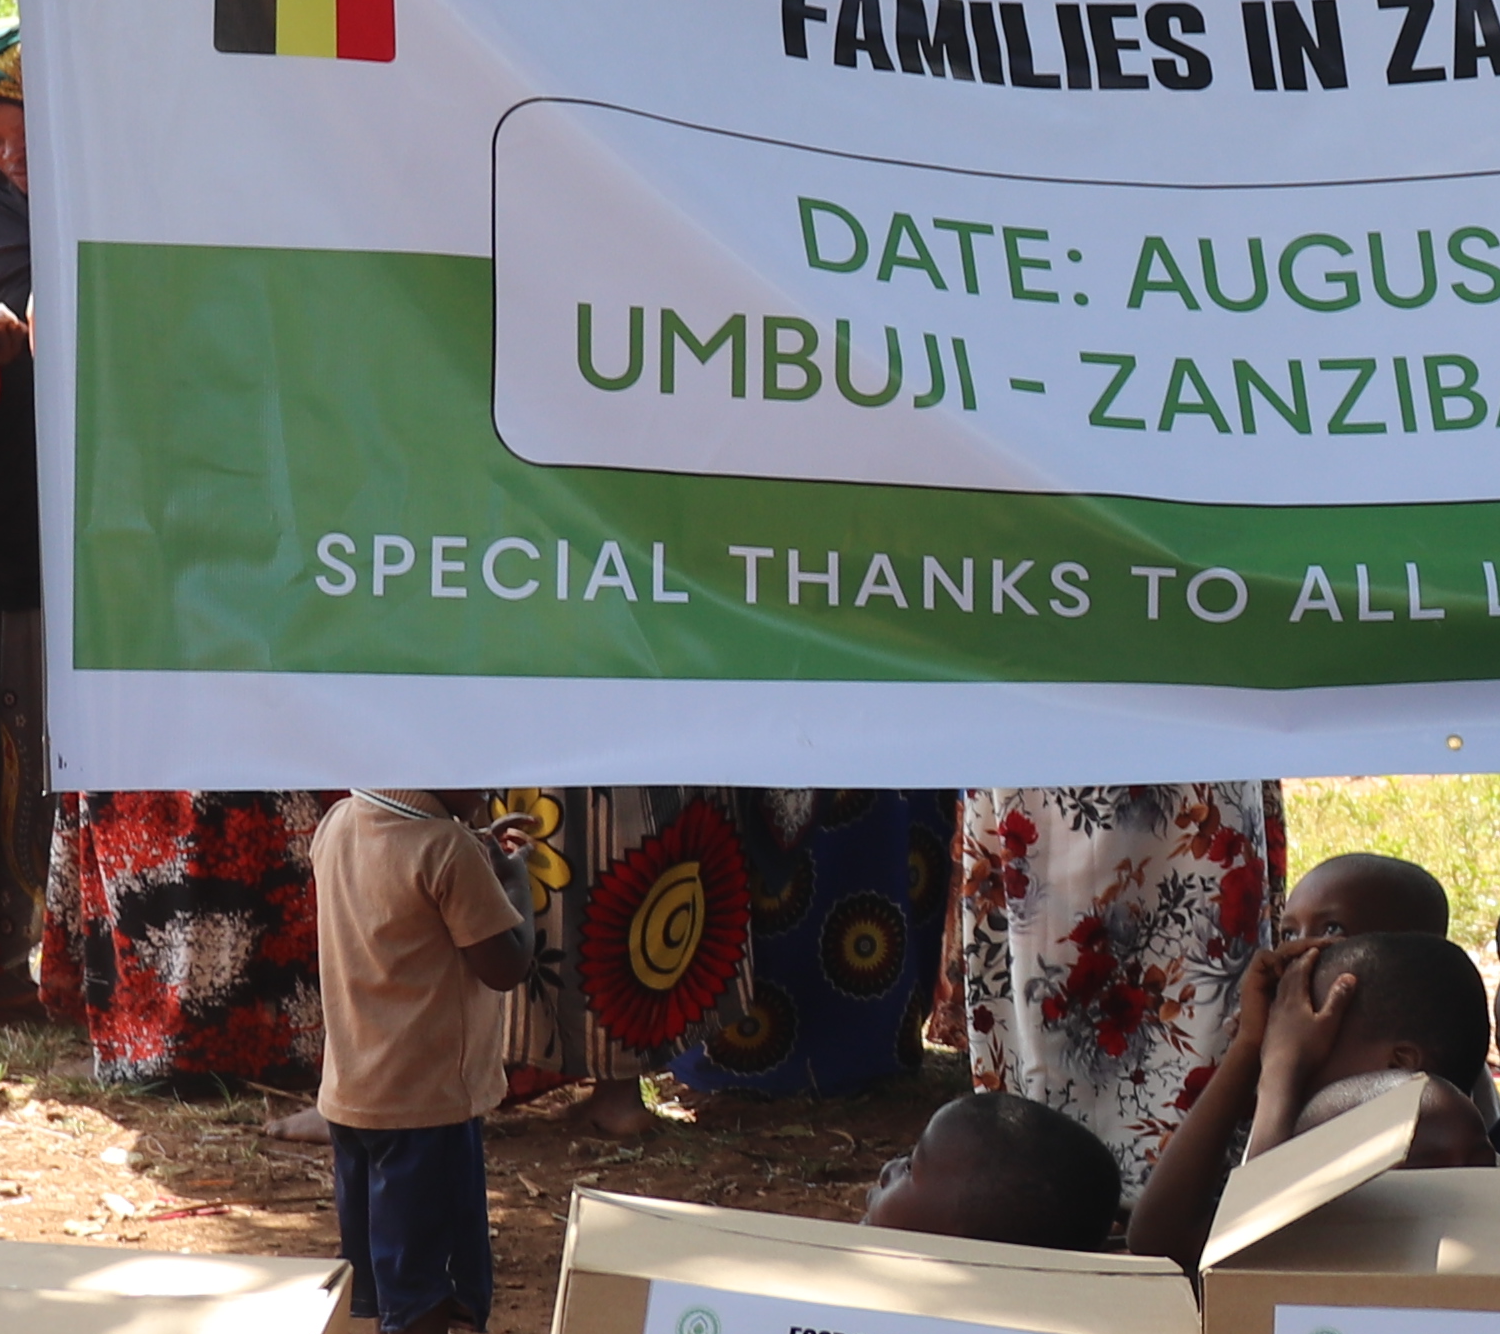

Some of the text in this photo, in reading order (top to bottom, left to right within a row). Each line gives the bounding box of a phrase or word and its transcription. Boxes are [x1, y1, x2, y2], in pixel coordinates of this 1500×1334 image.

[1241, 0, 1349, 92] IN
[797, 196, 1089, 307] DATE:
[577, 302, 978, 412] UMBUJI
[1009, 377, 1046, 394] -
[314, 532, 690, 605] SPECIAL
[728, 544, 1091, 618] THANKS
[1130, 565, 1249, 624] TO
[1288, 563, 1445, 625] ALL
